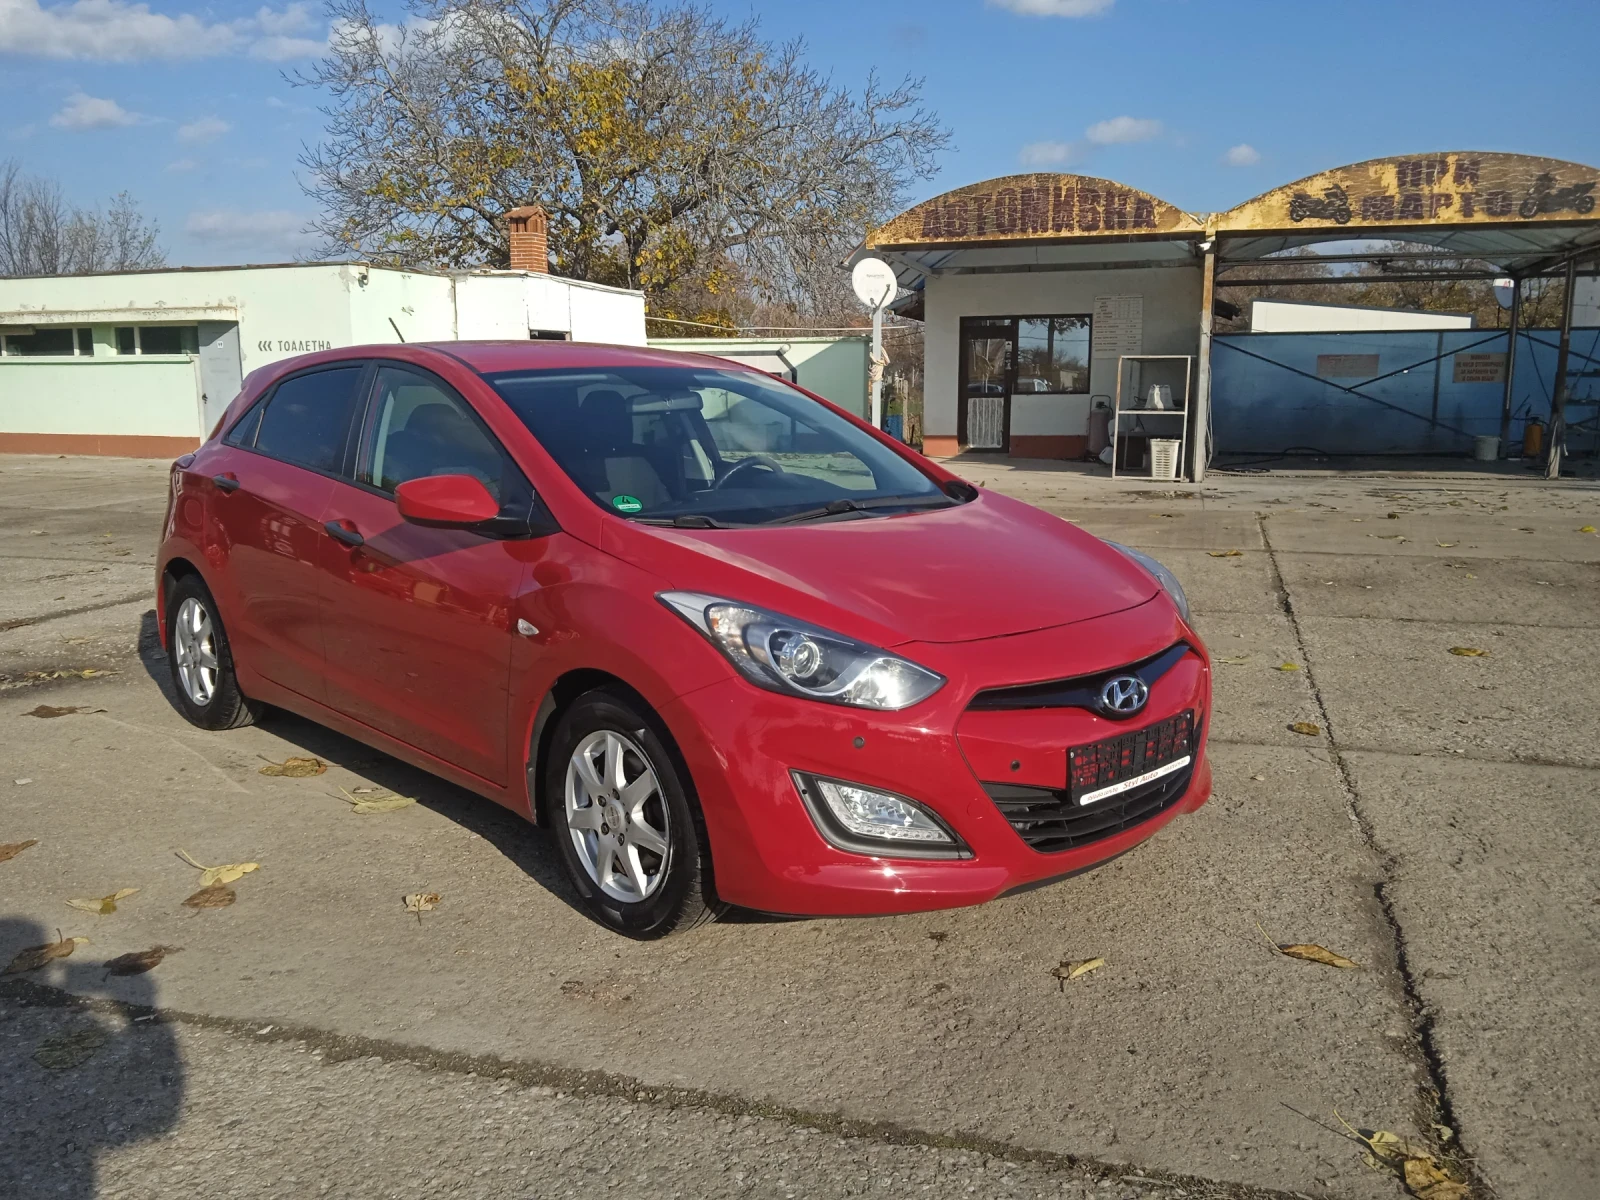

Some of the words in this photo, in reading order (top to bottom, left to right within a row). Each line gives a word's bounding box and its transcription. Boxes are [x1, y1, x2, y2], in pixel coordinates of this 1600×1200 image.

[1397, 160, 1480, 188] ПРИ
[921, 186, 1157, 238] АВТОМИВКА
[1361, 191, 1513, 221] МАРТО
[278, 340, 332, 351] ТОАЛЕТНА
[1123, 778, 1139, 790] Styl
[1140, 771, 1159, 783] Auto
